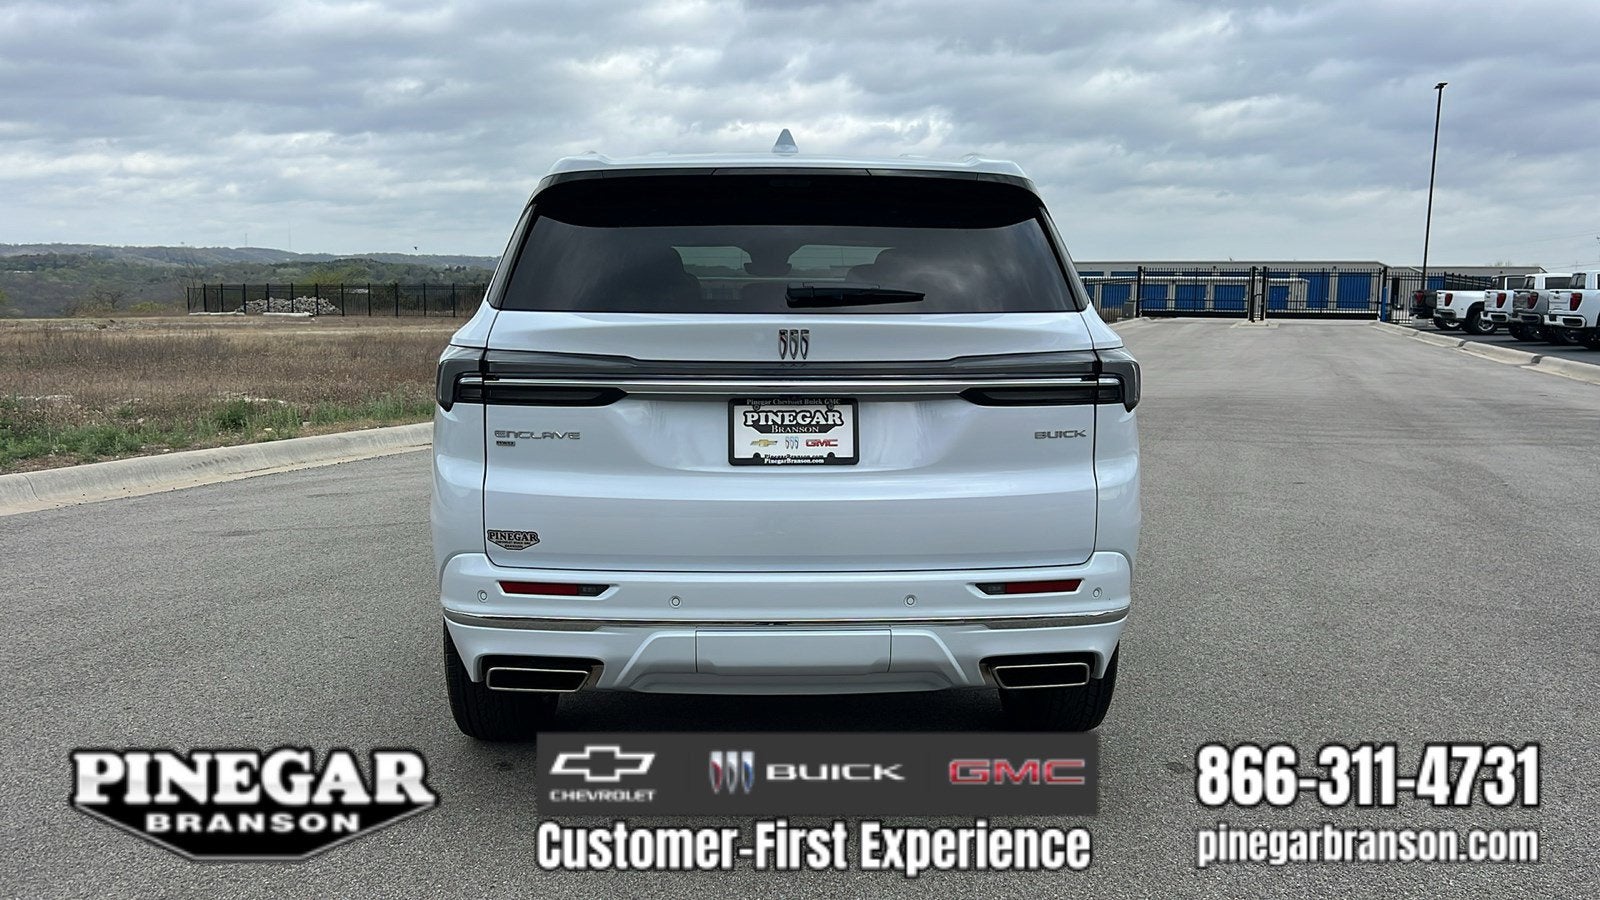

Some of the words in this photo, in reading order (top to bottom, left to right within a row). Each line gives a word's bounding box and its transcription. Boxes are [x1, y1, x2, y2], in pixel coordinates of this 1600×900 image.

[744, 411, 843, 425] PINEGAR
[771, 425, 820, 433] BRANSON
[494, 430, 581, 440] ENCLAVE
[1034, 430, 1087, 439] BUICK
[805, 439, 839, 447] GMC
[489, 531, 538, 542] PINEGAR
